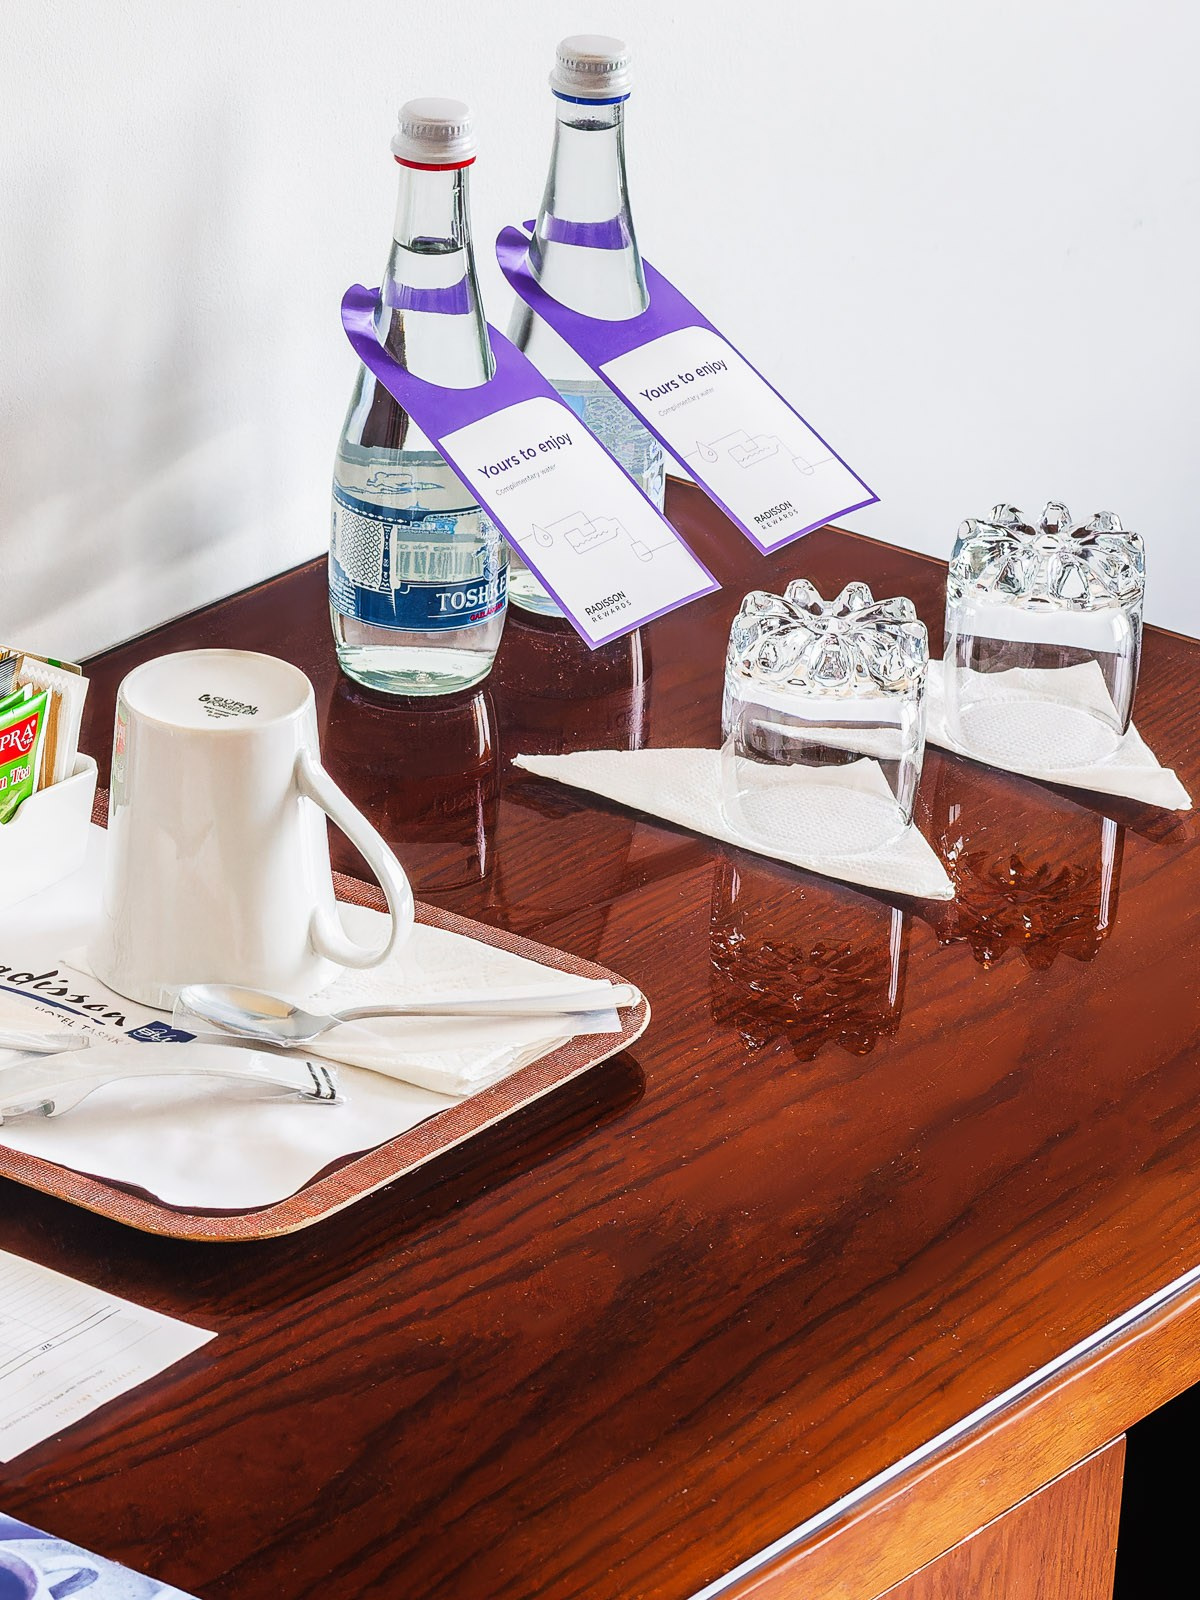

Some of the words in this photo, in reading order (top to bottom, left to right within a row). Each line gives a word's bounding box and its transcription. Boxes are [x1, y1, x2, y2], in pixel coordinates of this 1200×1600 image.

[639, 378, 680, 402] Yours
[678, 371, 695, 385] to
[695, 358, 729, 377] enjoy
[658, 393, 702, 417] Complimentary
[699, 386, 715, 399] water
[478, 454, 520, 479] Yours
[520, 446, 537, 462] to
[538, 432, 573, 454] enjoy
[495, 471, 542, 496] Complimentary
[539, 463, 556, 477] water
[754, 500, 794, 525] RADISSON
[761, 508, 799, 530] REWARDS
[584, 590, 627, 616] RADISSON
[591, 600, 633, 623] REWARDS
[10, 765, 31, 785] Tea
